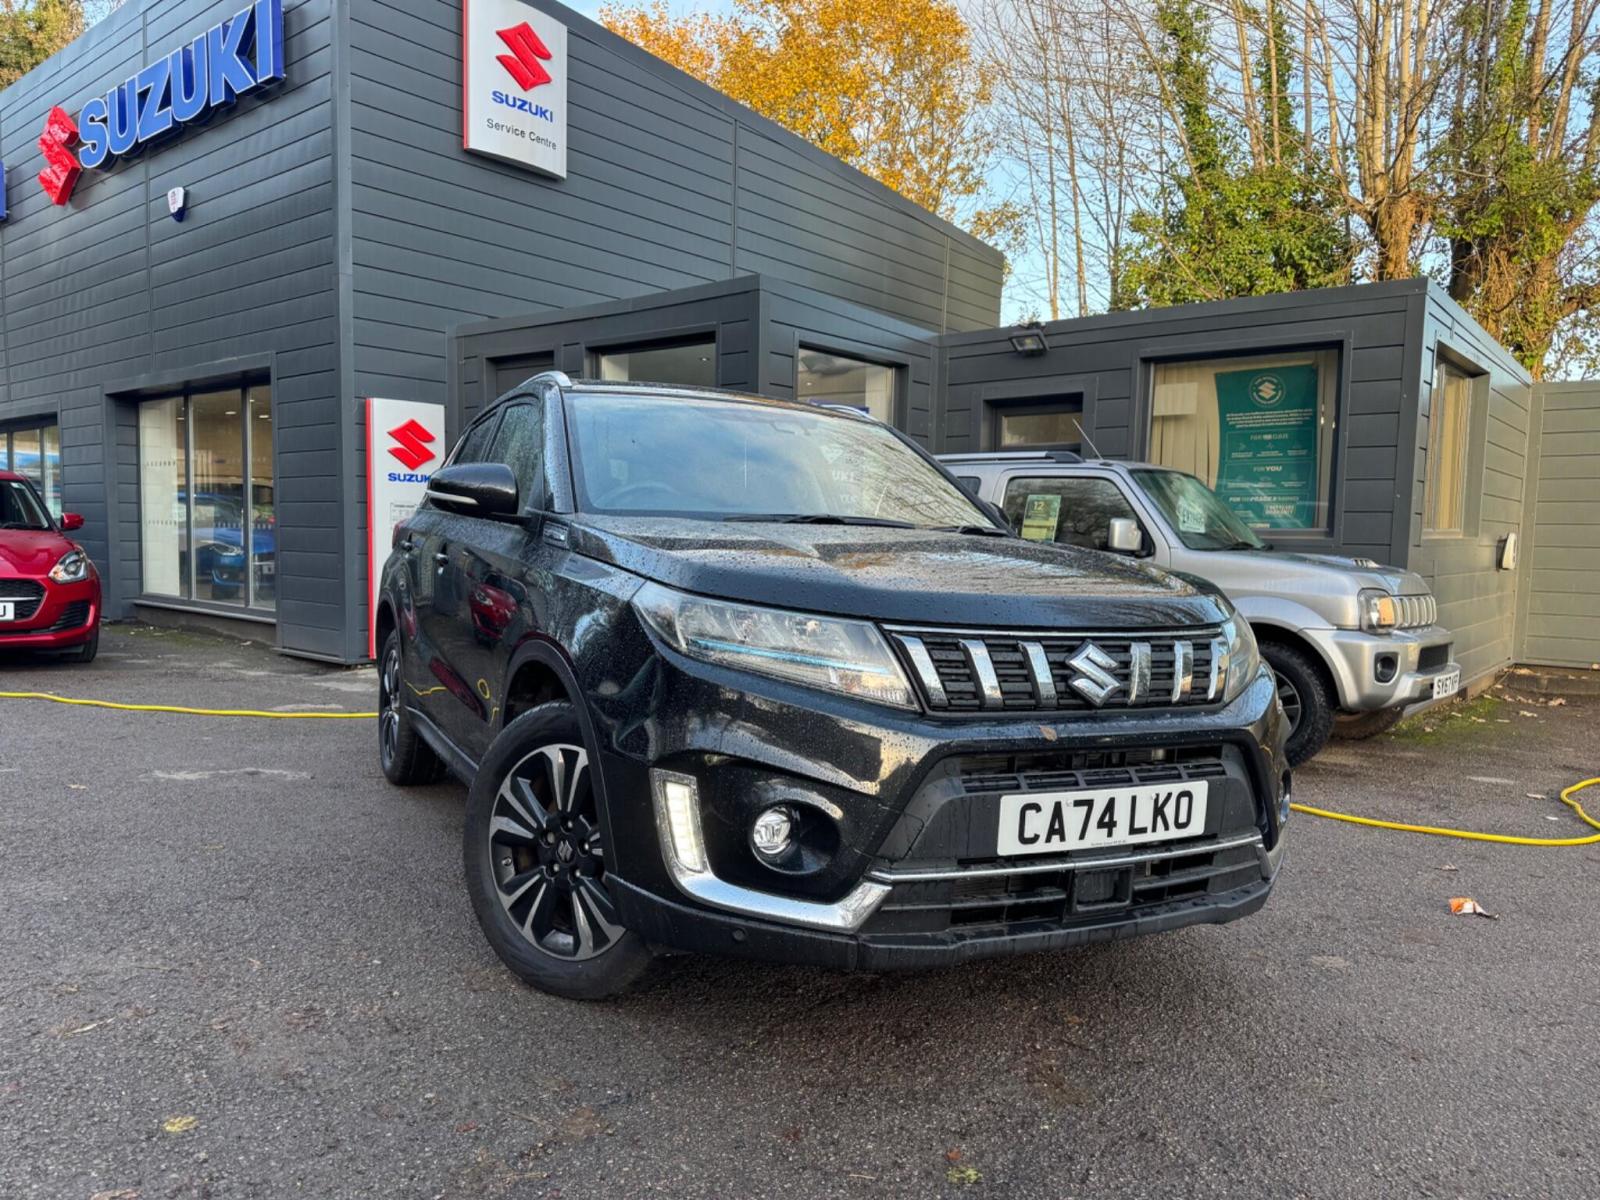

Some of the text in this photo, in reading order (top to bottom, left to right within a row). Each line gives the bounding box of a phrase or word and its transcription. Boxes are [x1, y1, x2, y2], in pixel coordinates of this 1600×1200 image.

[79, 0, 283, 170] SUZUKI
[491, 90, 553, 123] SUZUKI
[486, 118, 557, 150] Service Centre
[388, 472, 432, 483] SUZUK
